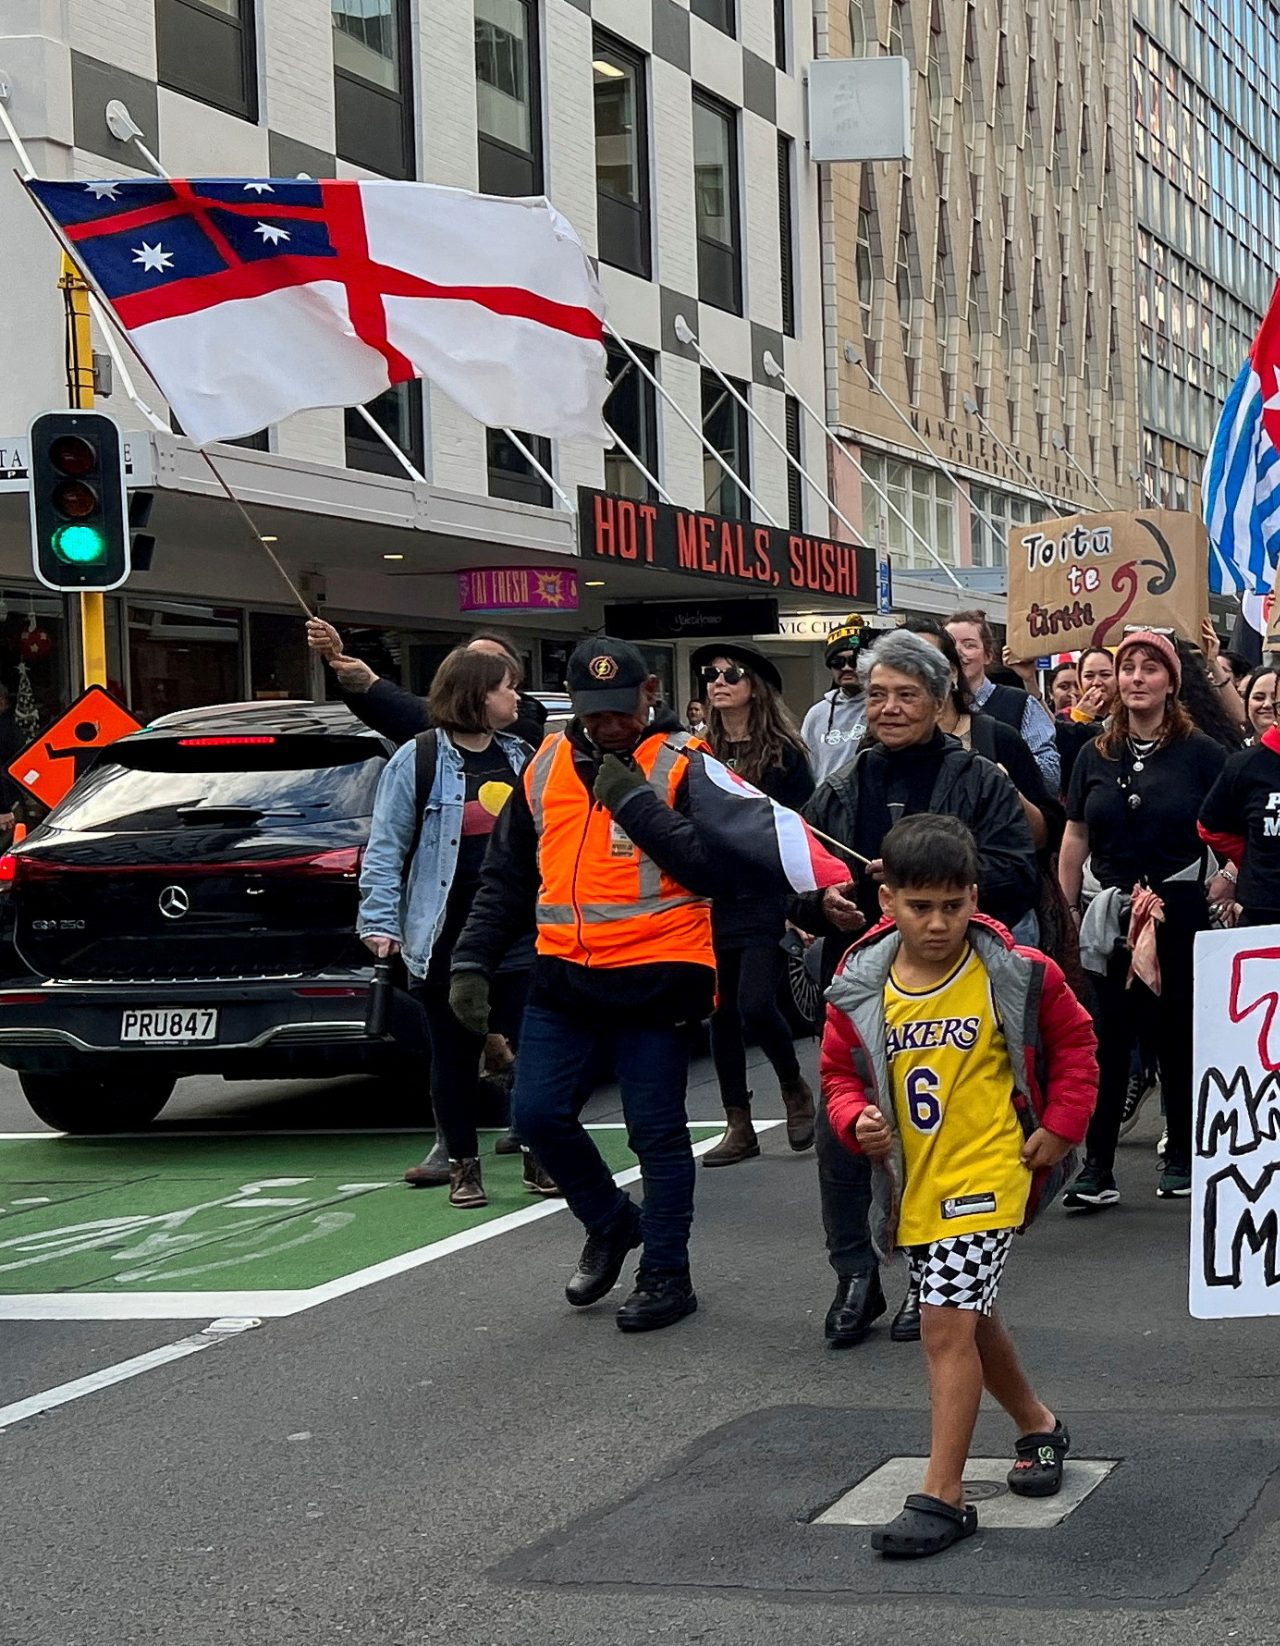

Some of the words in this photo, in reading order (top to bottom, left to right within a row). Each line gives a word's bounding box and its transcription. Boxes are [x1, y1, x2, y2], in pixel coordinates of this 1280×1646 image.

[910, 411, 1033, 473] MANCHESTER
[593, 494, 657, 563] HOT
[676, 511, 780, 587] MEALS,
[788, 534, 858, 597] SUSHI
[471, 571, 487, 605] EAT
[491, 570, 529, 603] FRESH
[1067, 564, 1101, 596] te
[123, 1011, 214, 1039] PRU847
[905, 1066, 942, 1135] 6
